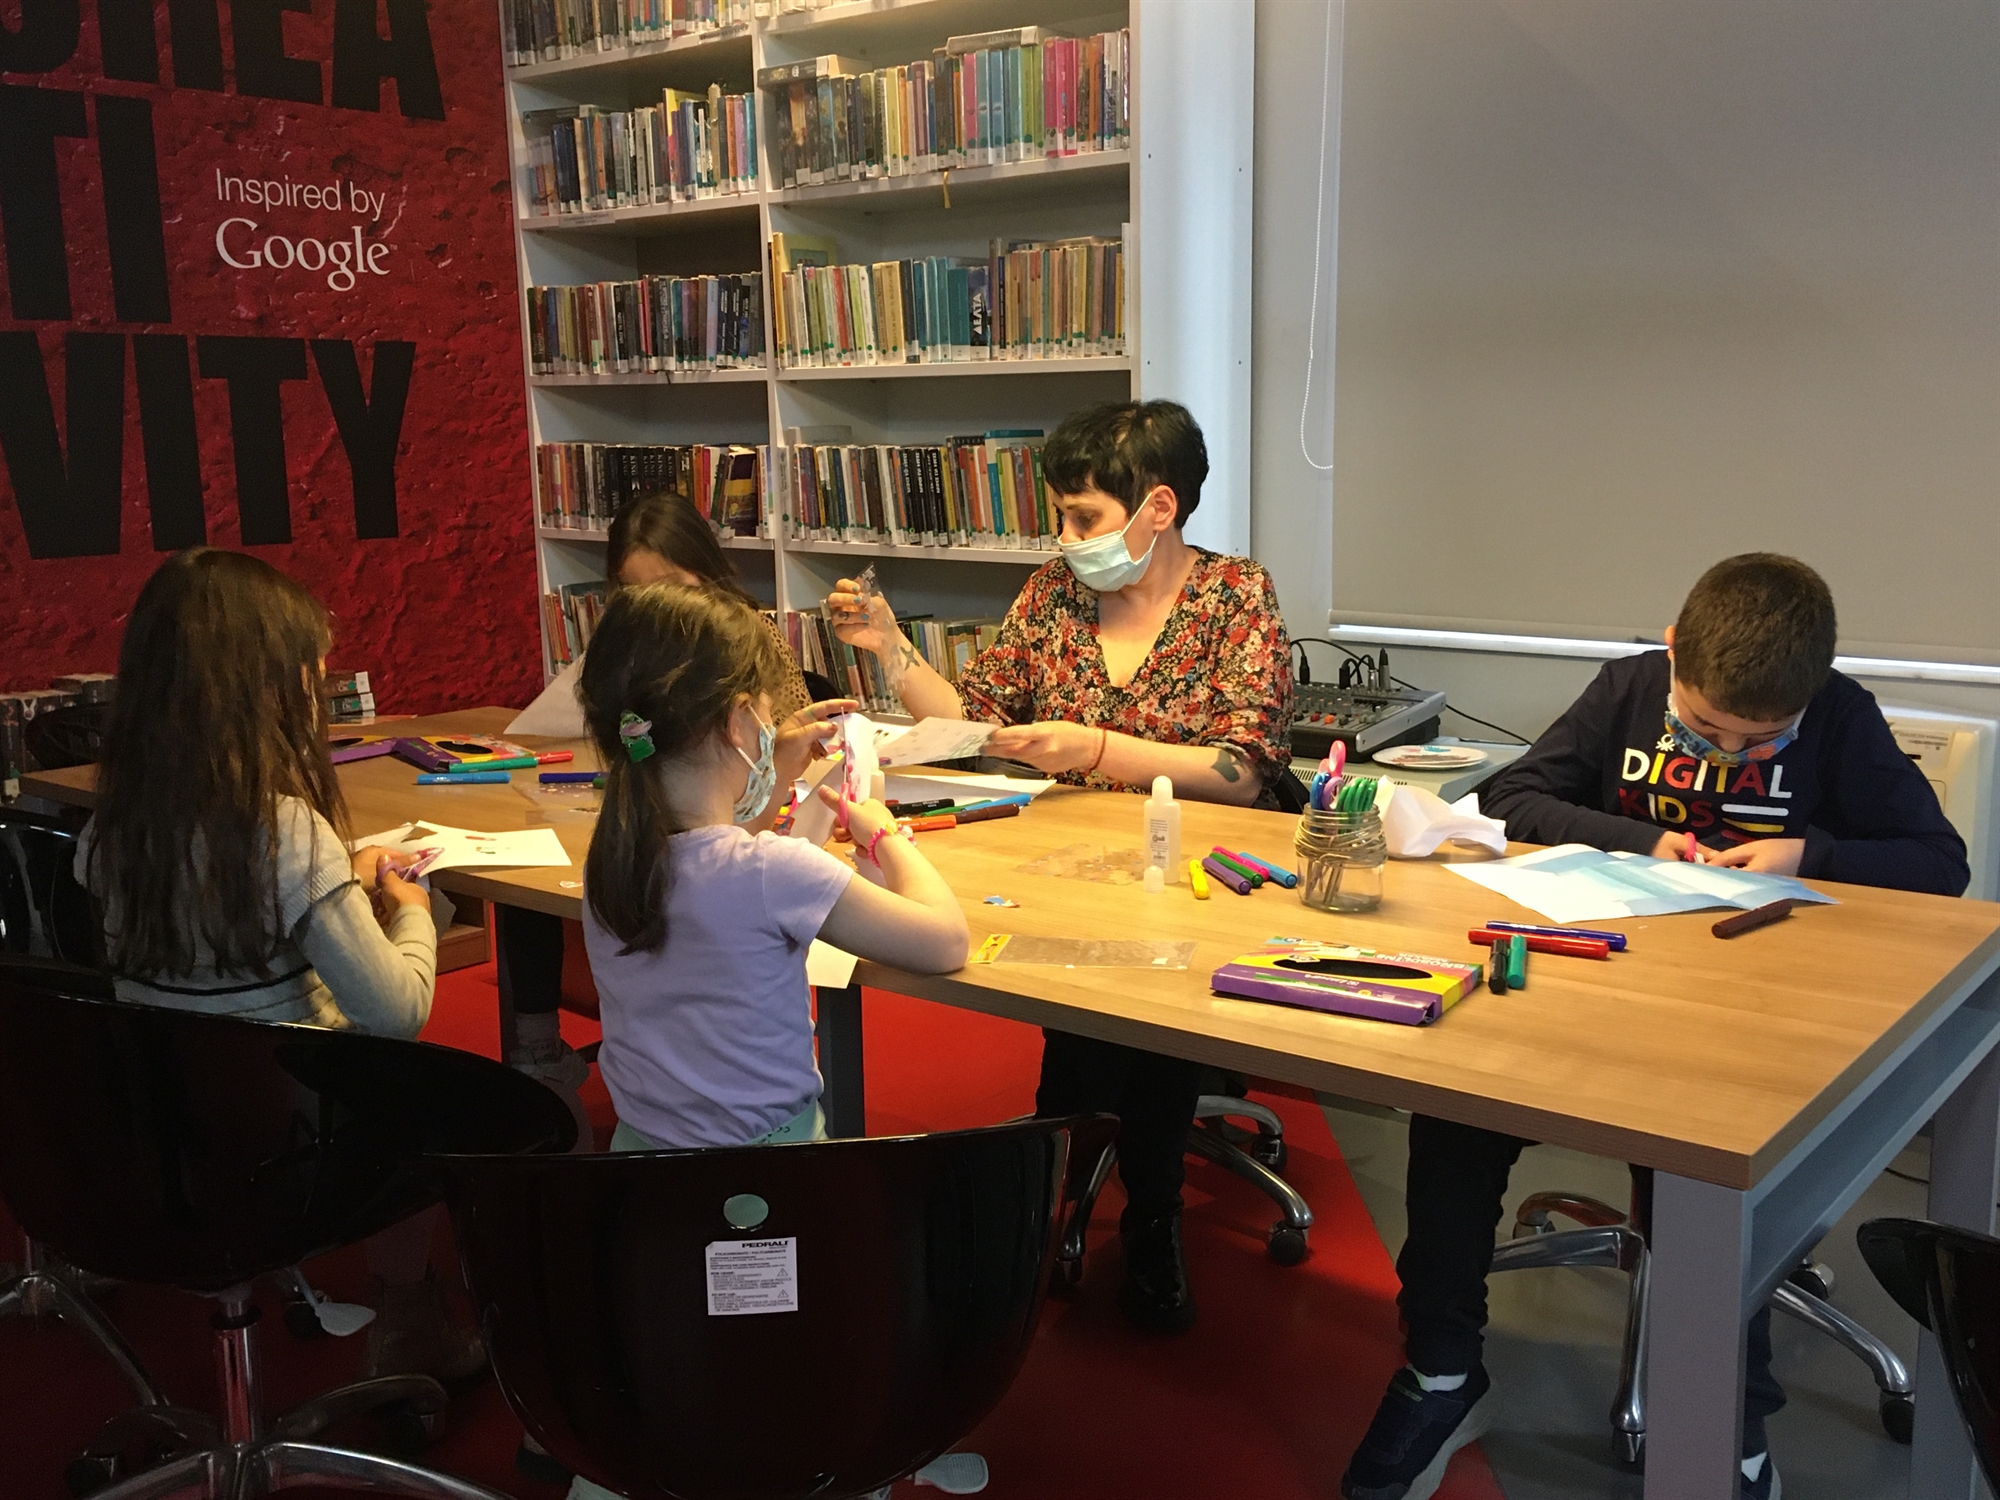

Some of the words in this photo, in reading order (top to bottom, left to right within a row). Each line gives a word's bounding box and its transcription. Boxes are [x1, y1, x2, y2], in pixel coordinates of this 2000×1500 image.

[216, 168, 341, 212] Inspired
[349, 180, 385, 222] by
[216, 217, 391, 291] Google
[0, 331, 416, 560] VITY
[1621, 747, 1793, 799] DIGITAL
[1618, 787, 1716, 828] KIDS
[742, 1240, 789, 1248] PEDRALI
